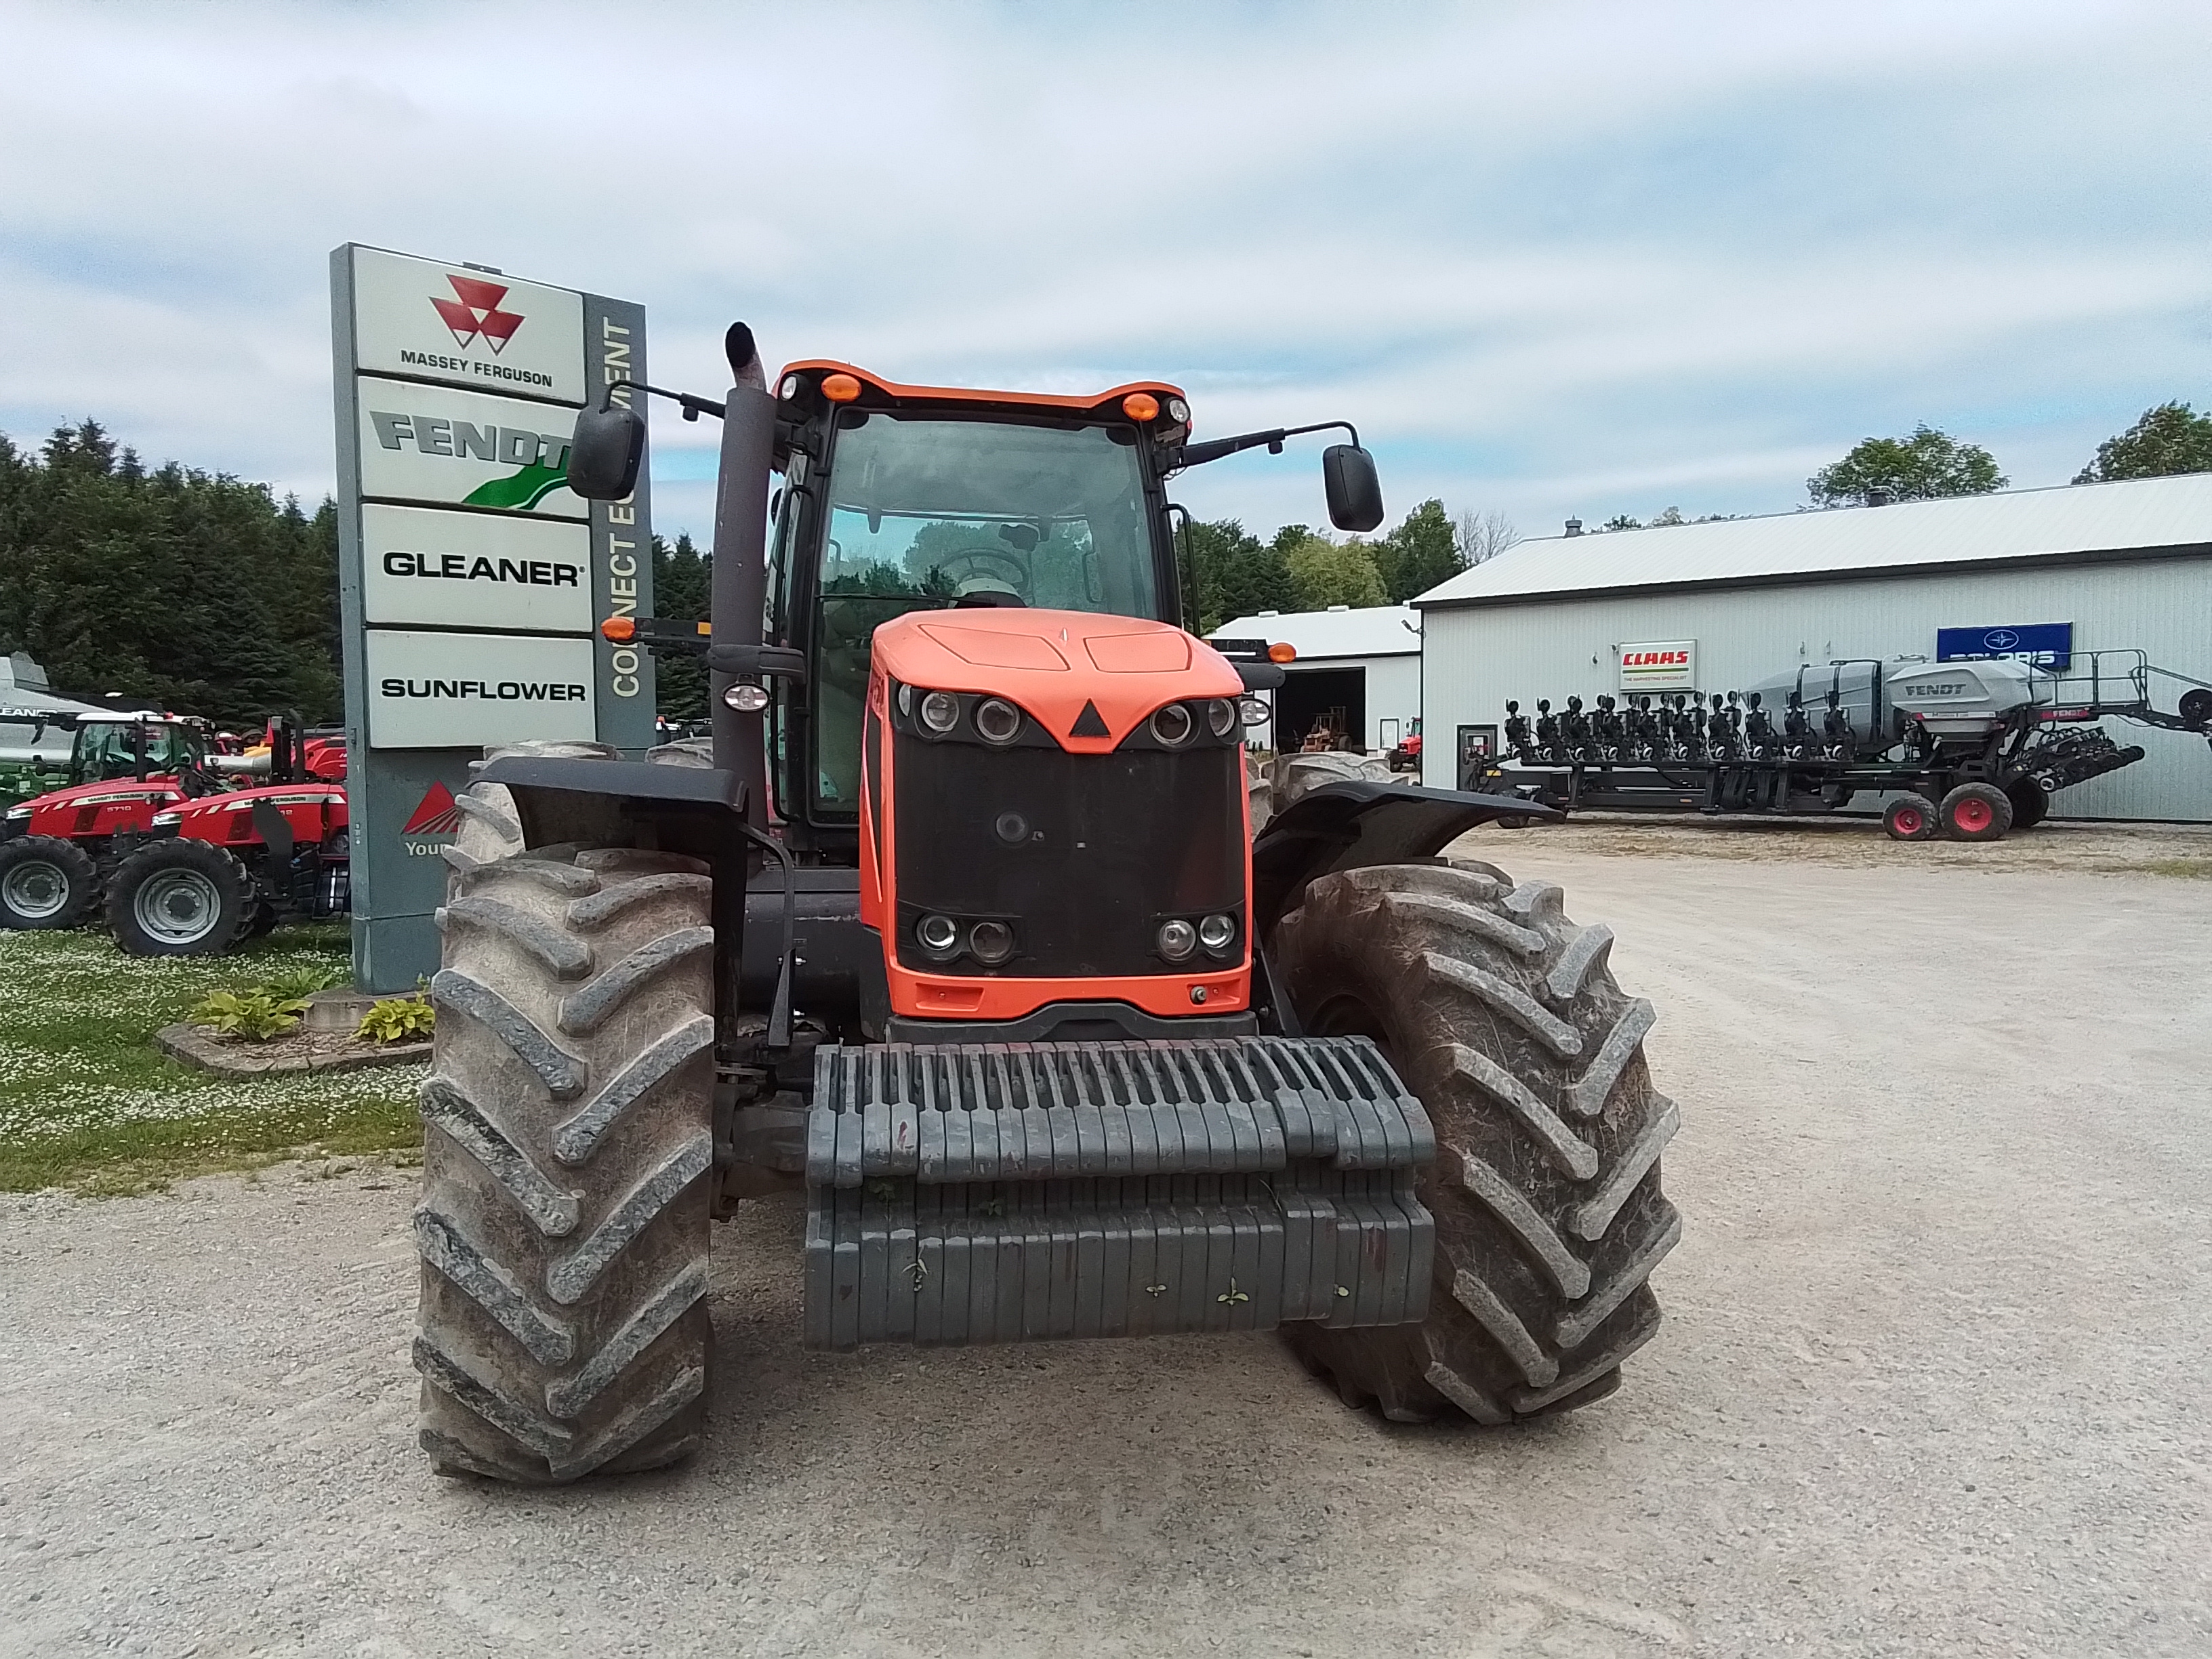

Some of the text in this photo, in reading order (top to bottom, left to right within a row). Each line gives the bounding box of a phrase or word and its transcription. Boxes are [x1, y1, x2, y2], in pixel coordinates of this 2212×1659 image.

[401, 349, 553, 388] MASSEY FERGUSON
[369, 410, 573, 470] FENDT
[383, 551, 579, 588] GLEANER
[609, 532, 640, 698] CONECT
[1622, 651, 1689, 666] CLAAS
[381, 678, 586, 701] SUNFLOWER
[1905, 683, 1967, 696] FENDT
